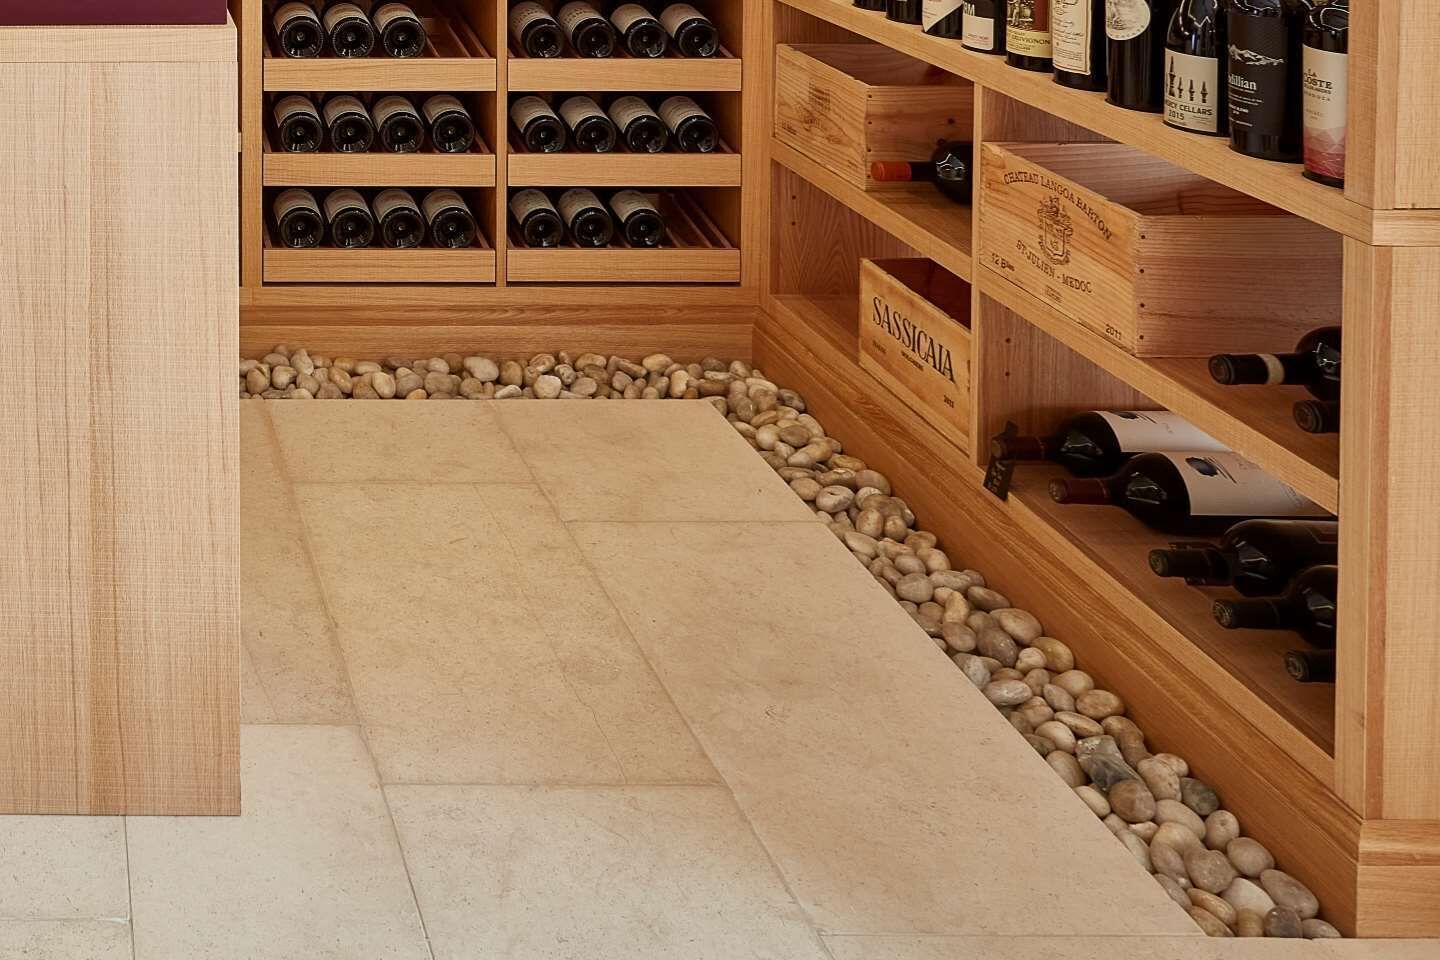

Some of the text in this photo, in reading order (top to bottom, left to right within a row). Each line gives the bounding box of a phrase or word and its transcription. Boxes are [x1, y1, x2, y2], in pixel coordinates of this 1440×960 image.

[1168, 109, 1186, 121] 2015
[1179, 104, 1213, 116] CELLARS
[872, 295, 956, 385] SASSICAIA
